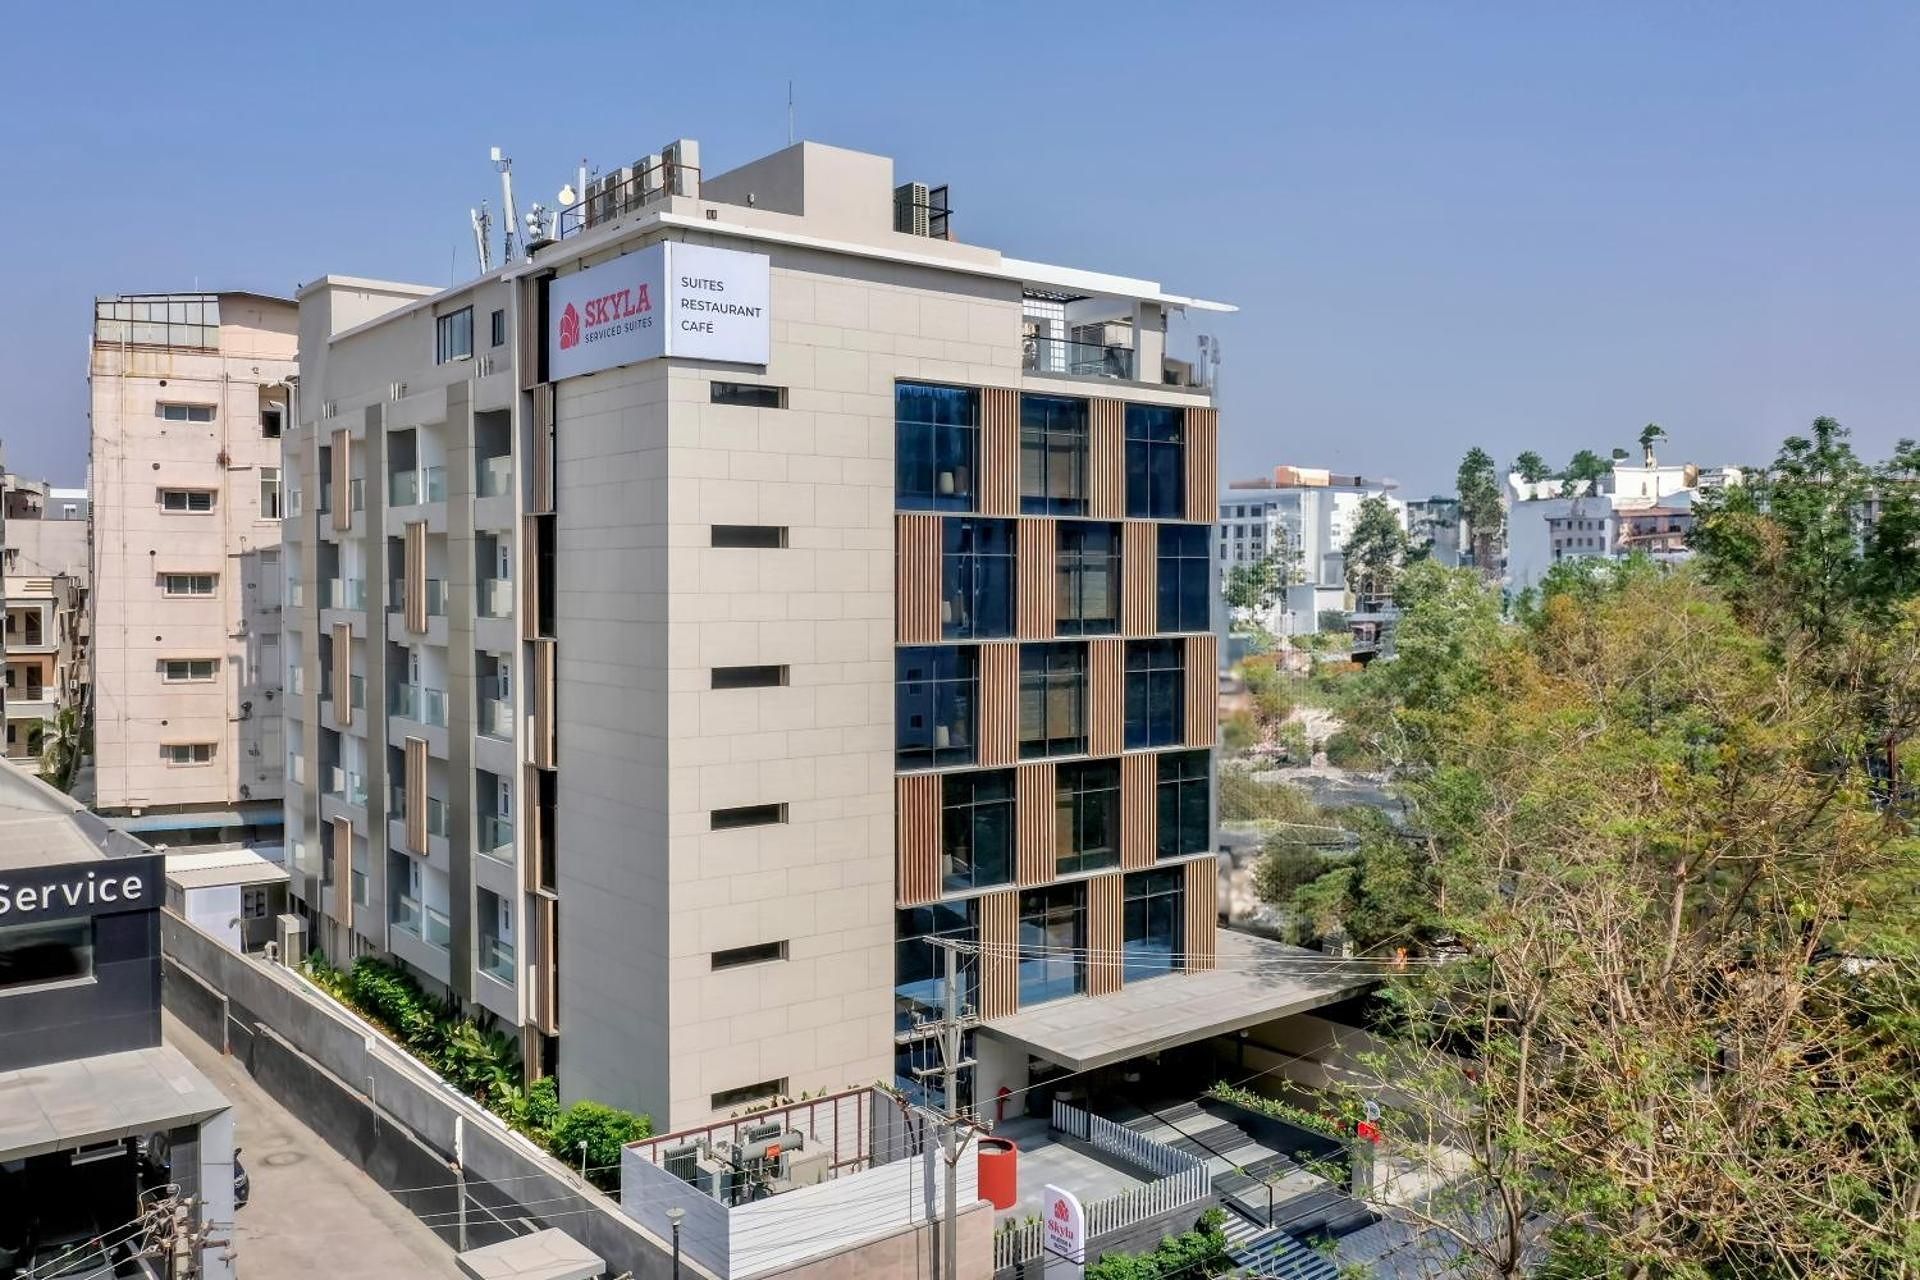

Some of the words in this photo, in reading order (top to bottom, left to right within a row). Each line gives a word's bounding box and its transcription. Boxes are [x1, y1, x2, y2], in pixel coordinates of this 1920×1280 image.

[681, 276, 724, 292] SUITES
[585, 283, 652, 328] SKYLA
[681, 298, 762, 318] RESTAURANT
[585, 325, 622, 344] SERVICED
[624, 316, 653, 333] SUITES
[681, 320, 714, 334] CAFÉ
